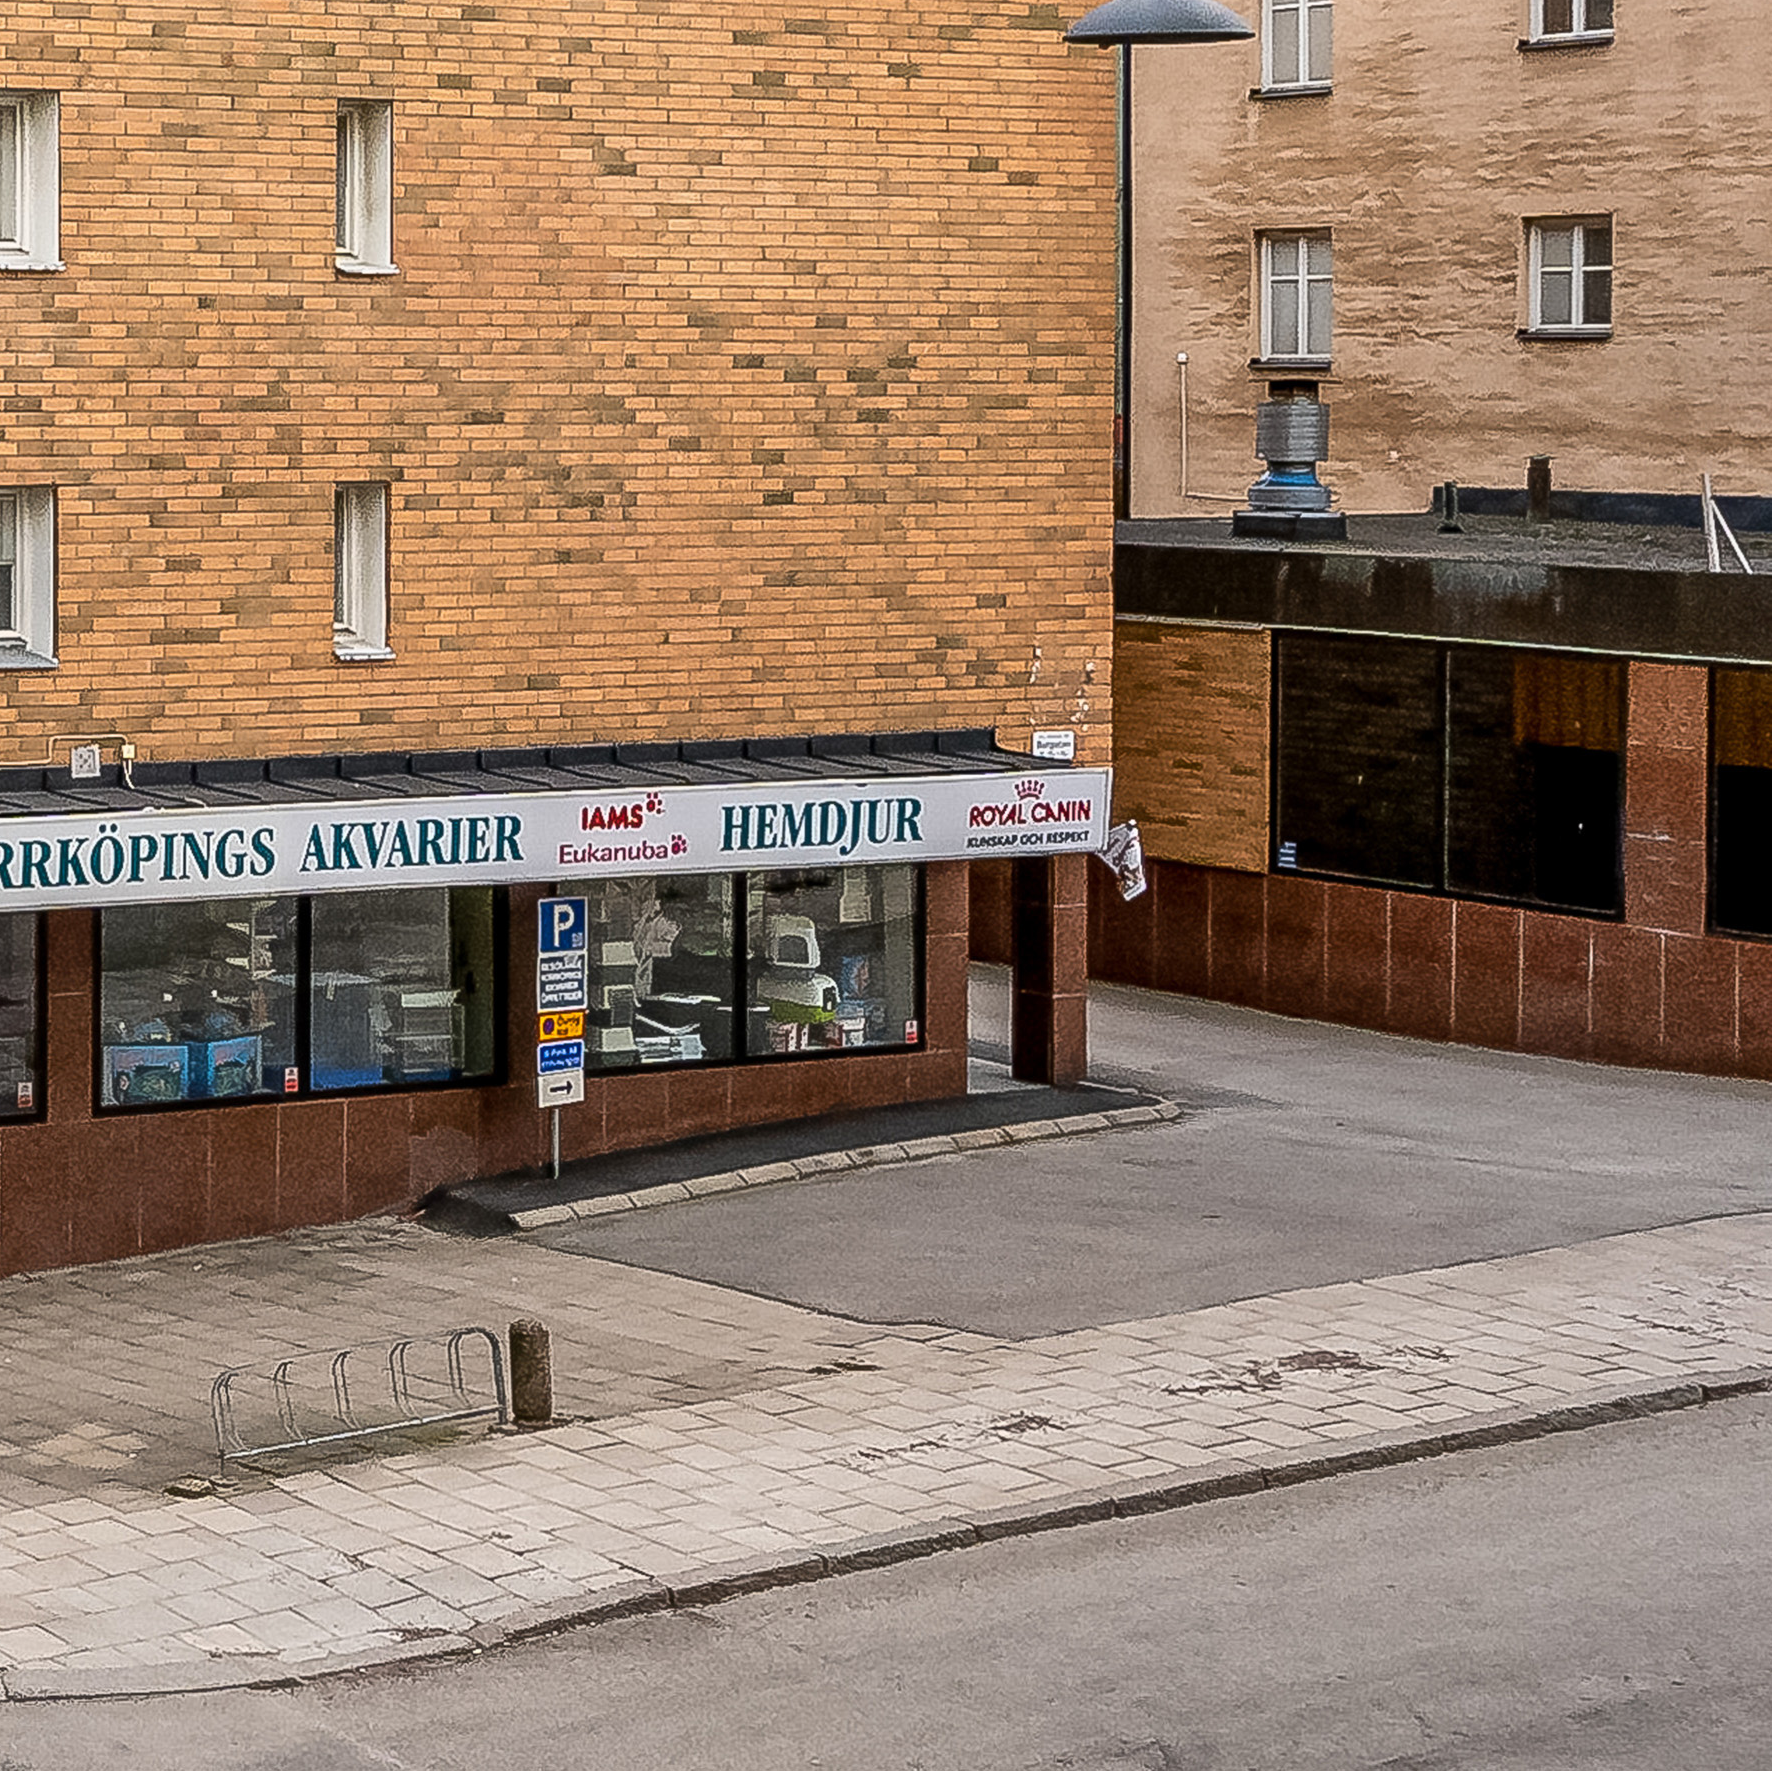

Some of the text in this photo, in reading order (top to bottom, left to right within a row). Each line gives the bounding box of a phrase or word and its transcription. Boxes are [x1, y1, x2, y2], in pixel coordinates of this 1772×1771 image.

[581, 803, 643, 831] IAMS
[969, 799, 1091, 828] ROYAL CANIN
[299, 815, 524, 873] AKVARIER
[720, 798, 923, 856] HEMDJUR
[559, 840, 668, 864] Eukanuba
[554, 904, 575, 947] P
